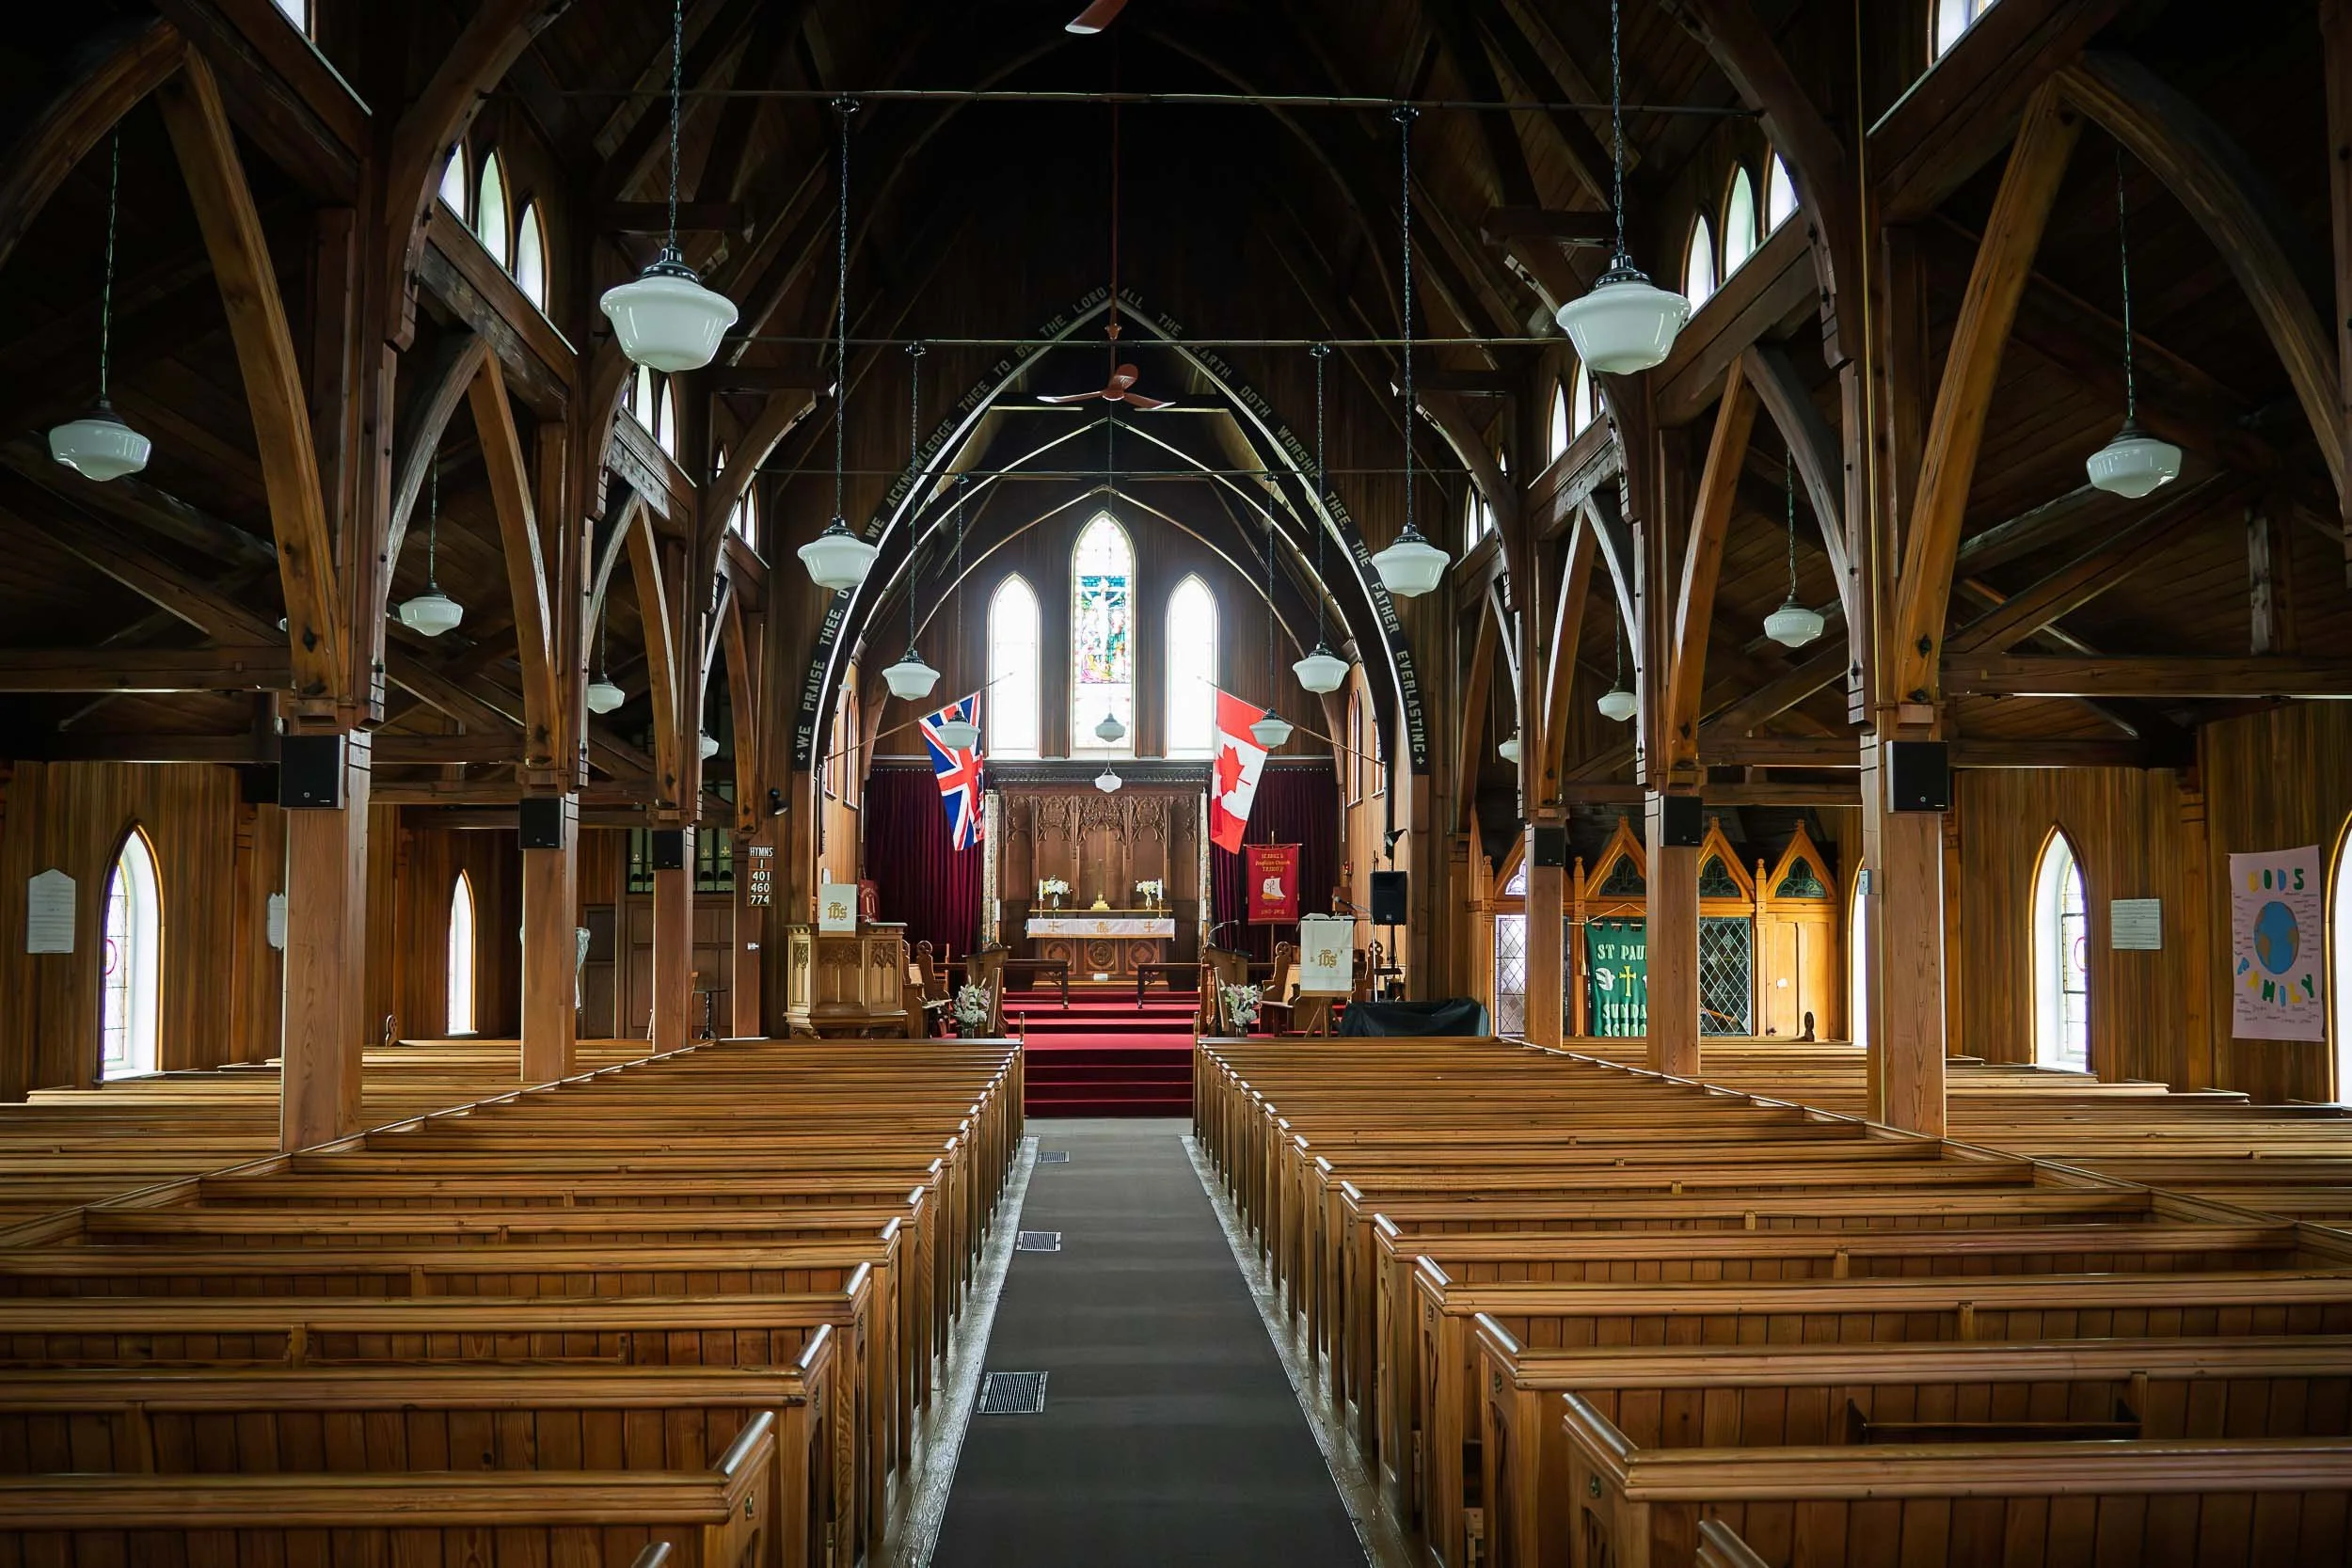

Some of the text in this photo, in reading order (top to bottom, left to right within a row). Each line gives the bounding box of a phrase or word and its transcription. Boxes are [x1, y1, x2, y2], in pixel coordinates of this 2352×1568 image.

[1072, 287, 1107, 314] LORD
[1039, 314, 1067, 336] THE
[993, 359, 1011, 377] TO
[957, 380, 991, 414] THEE
[866, 516, 885, 539] WE
[1119, 288, 1144, 309] ALL
[1158, 312, 1183, 336] THE
[1191, 345, 1234, 379] EARTH
[1238, 386, 1272, 418] DOTH
[1352, 539, 1373, 567] THE
[1371, 582, 1400, 634] FATHER
[1396, 650, 1426, 752] EVERLASTING
[818, 608, 846, 646] THEE,
[803, 659, 826, 712] PRAISE
[797, 726, 812, 749] WE
[750, 847, 773, 857] HYMNS
[753, 871, 771, 881] 401
[751, 882, 770, 893] 460
[751, 895, 770, 905] 774
[1597, 943, 1647, 960] ST PAU
